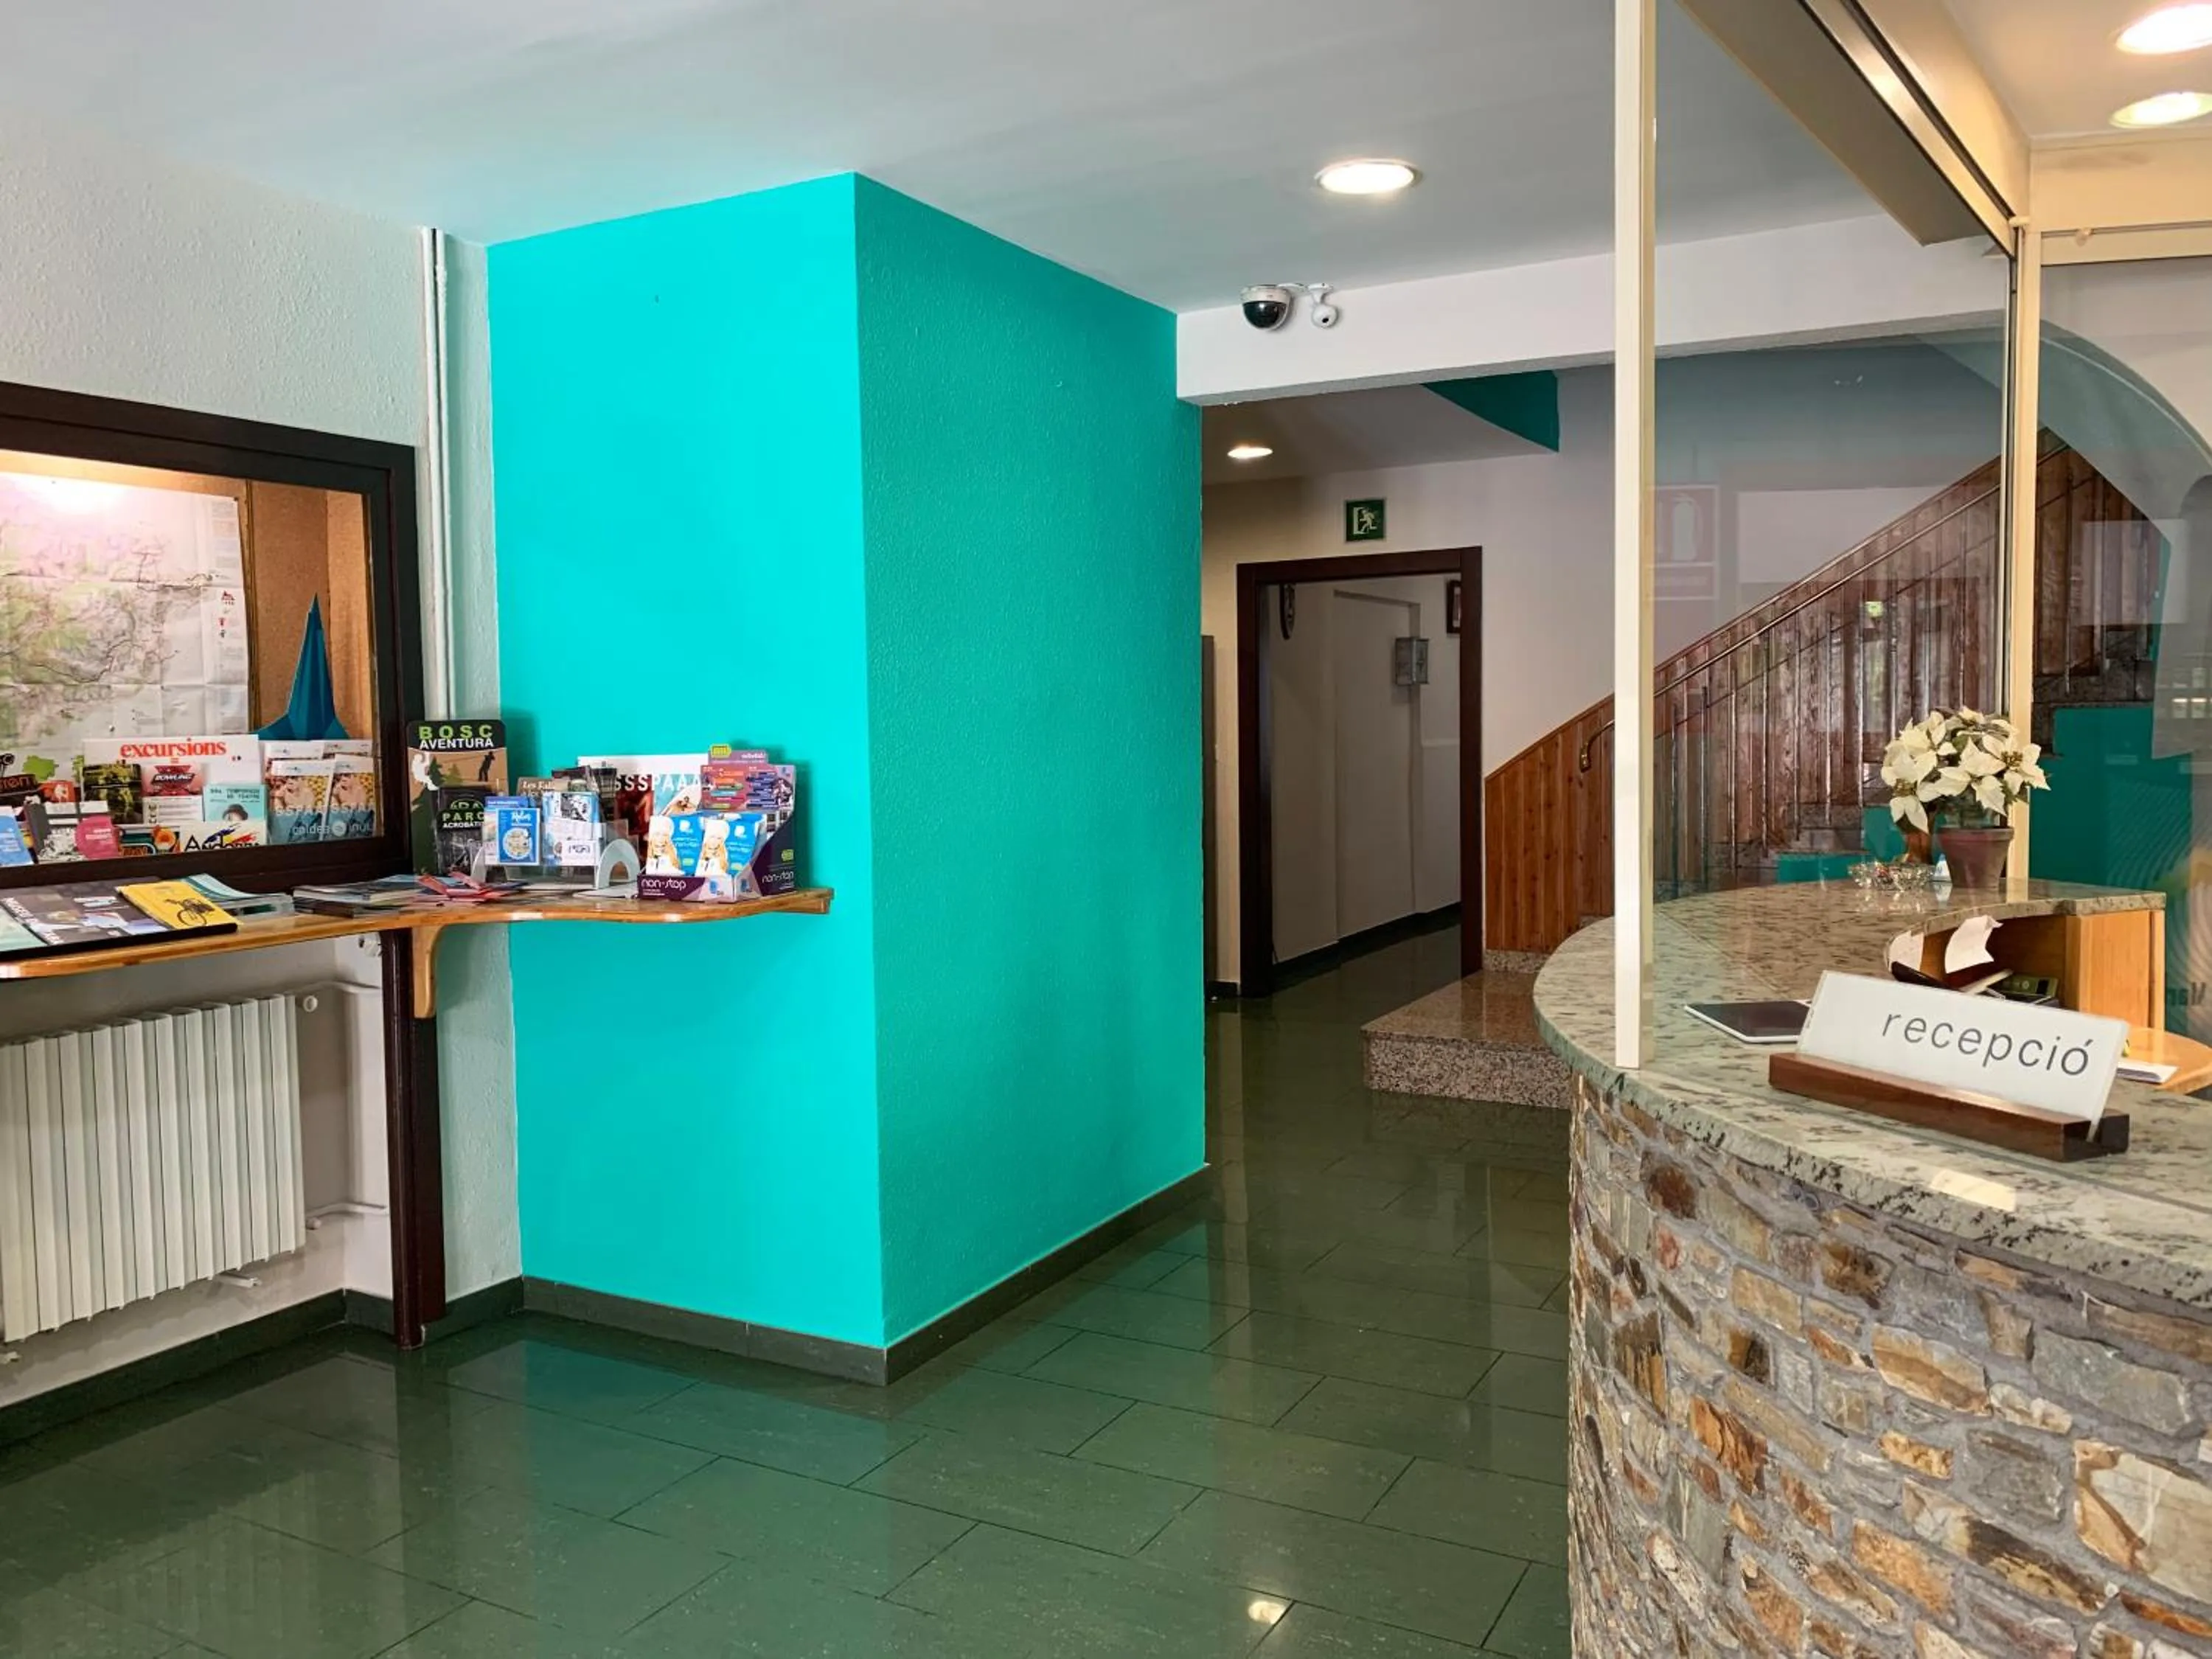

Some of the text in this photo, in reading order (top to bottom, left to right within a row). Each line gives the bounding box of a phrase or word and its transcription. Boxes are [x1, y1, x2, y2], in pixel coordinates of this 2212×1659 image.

[419, 725, 493, 739] BOSC
[119, 739, 227, 758] excursions
[419, 737, 494, 749] AVENTURA
[442, 812, 484, 821] PARC
[641, 878, 686, 891] non-stop
[1882, 1013, 2094, 1076] recepció
